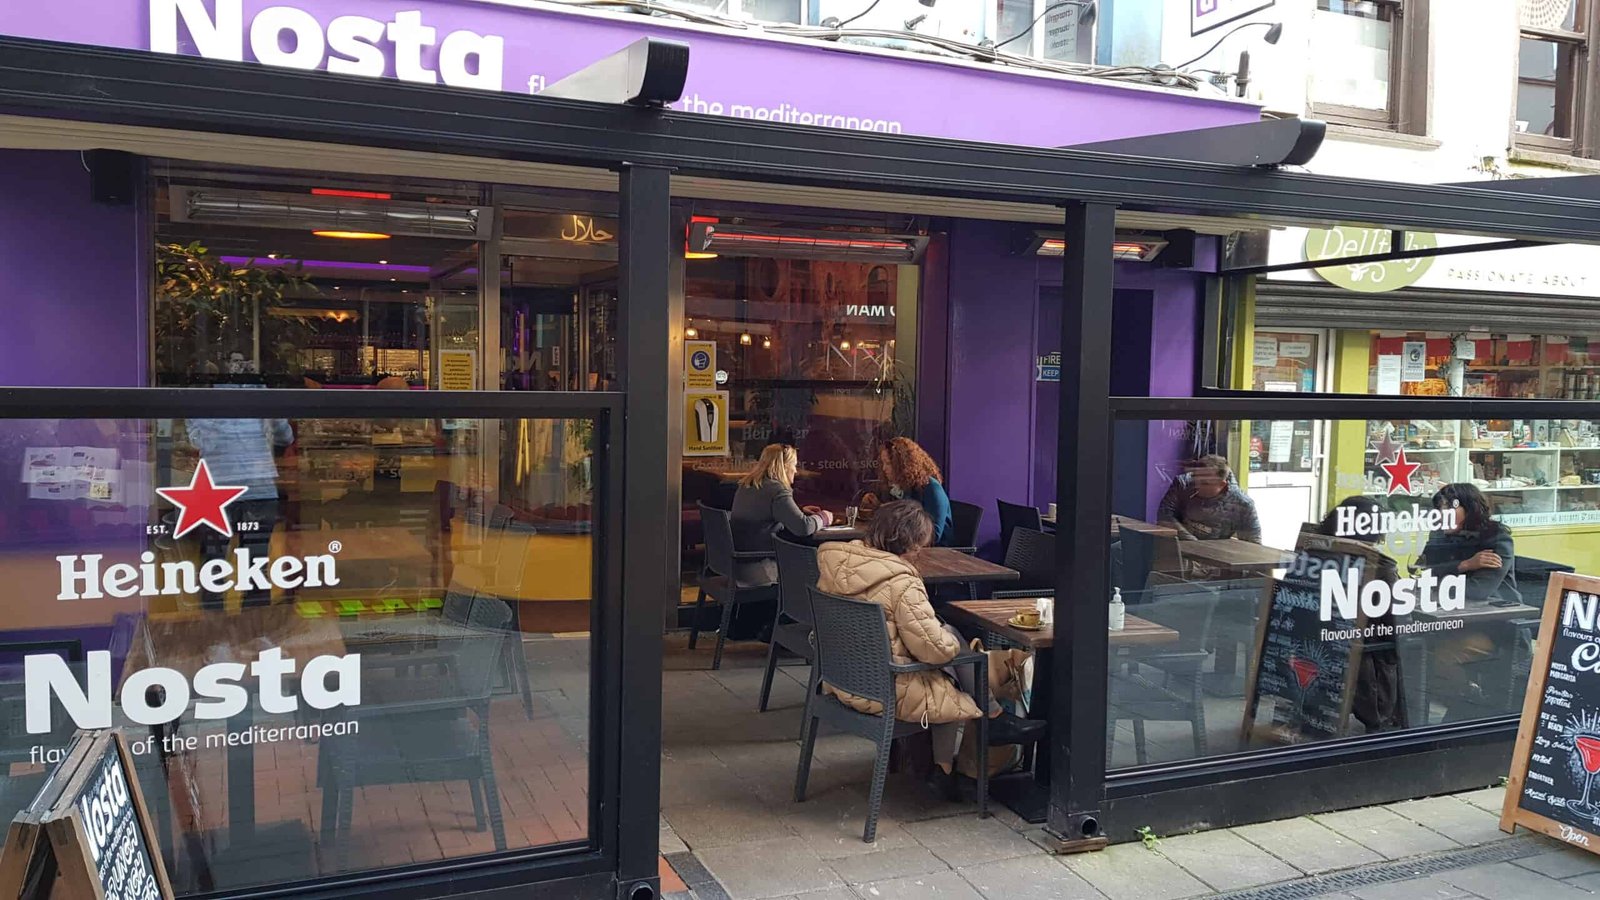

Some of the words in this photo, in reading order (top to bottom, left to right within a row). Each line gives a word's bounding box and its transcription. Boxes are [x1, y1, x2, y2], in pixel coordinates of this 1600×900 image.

[149, 0, 504, 91] Nosta
[682, 94, 724, 115] the
[730, 97, 902, 134] mediterranean
[561, 214, 614, 242] حلال
[1042, 369, 1060, 377] KEEP
[1043, 354, 1061, 365] FIRE
[818, 457, 849, 470] steak
[146, 525, 169, 535] EST.
[236, 522, 260, 532] 1873
[1335, 502, 1458, 537] Heineken
[56, 547, 340, 601] Heineken
[1319, 567, 1467, 622] Nosta
[1320, 623, 1362, 642] flavours
[1363, 623, 1375, 639] of
[1376, 623, 1394, 638] the
[1395, 618, 1464, 636] mediterranean
[1562, 628, 1594, 642] flavours
[23, 646, 362, 734] Nosta
[131, 735, 156, 756] of
[161, 731, 198, 753] the
[205, 719, 359, 749] mediterranean
[1558, 824, 1591, 847] Open
